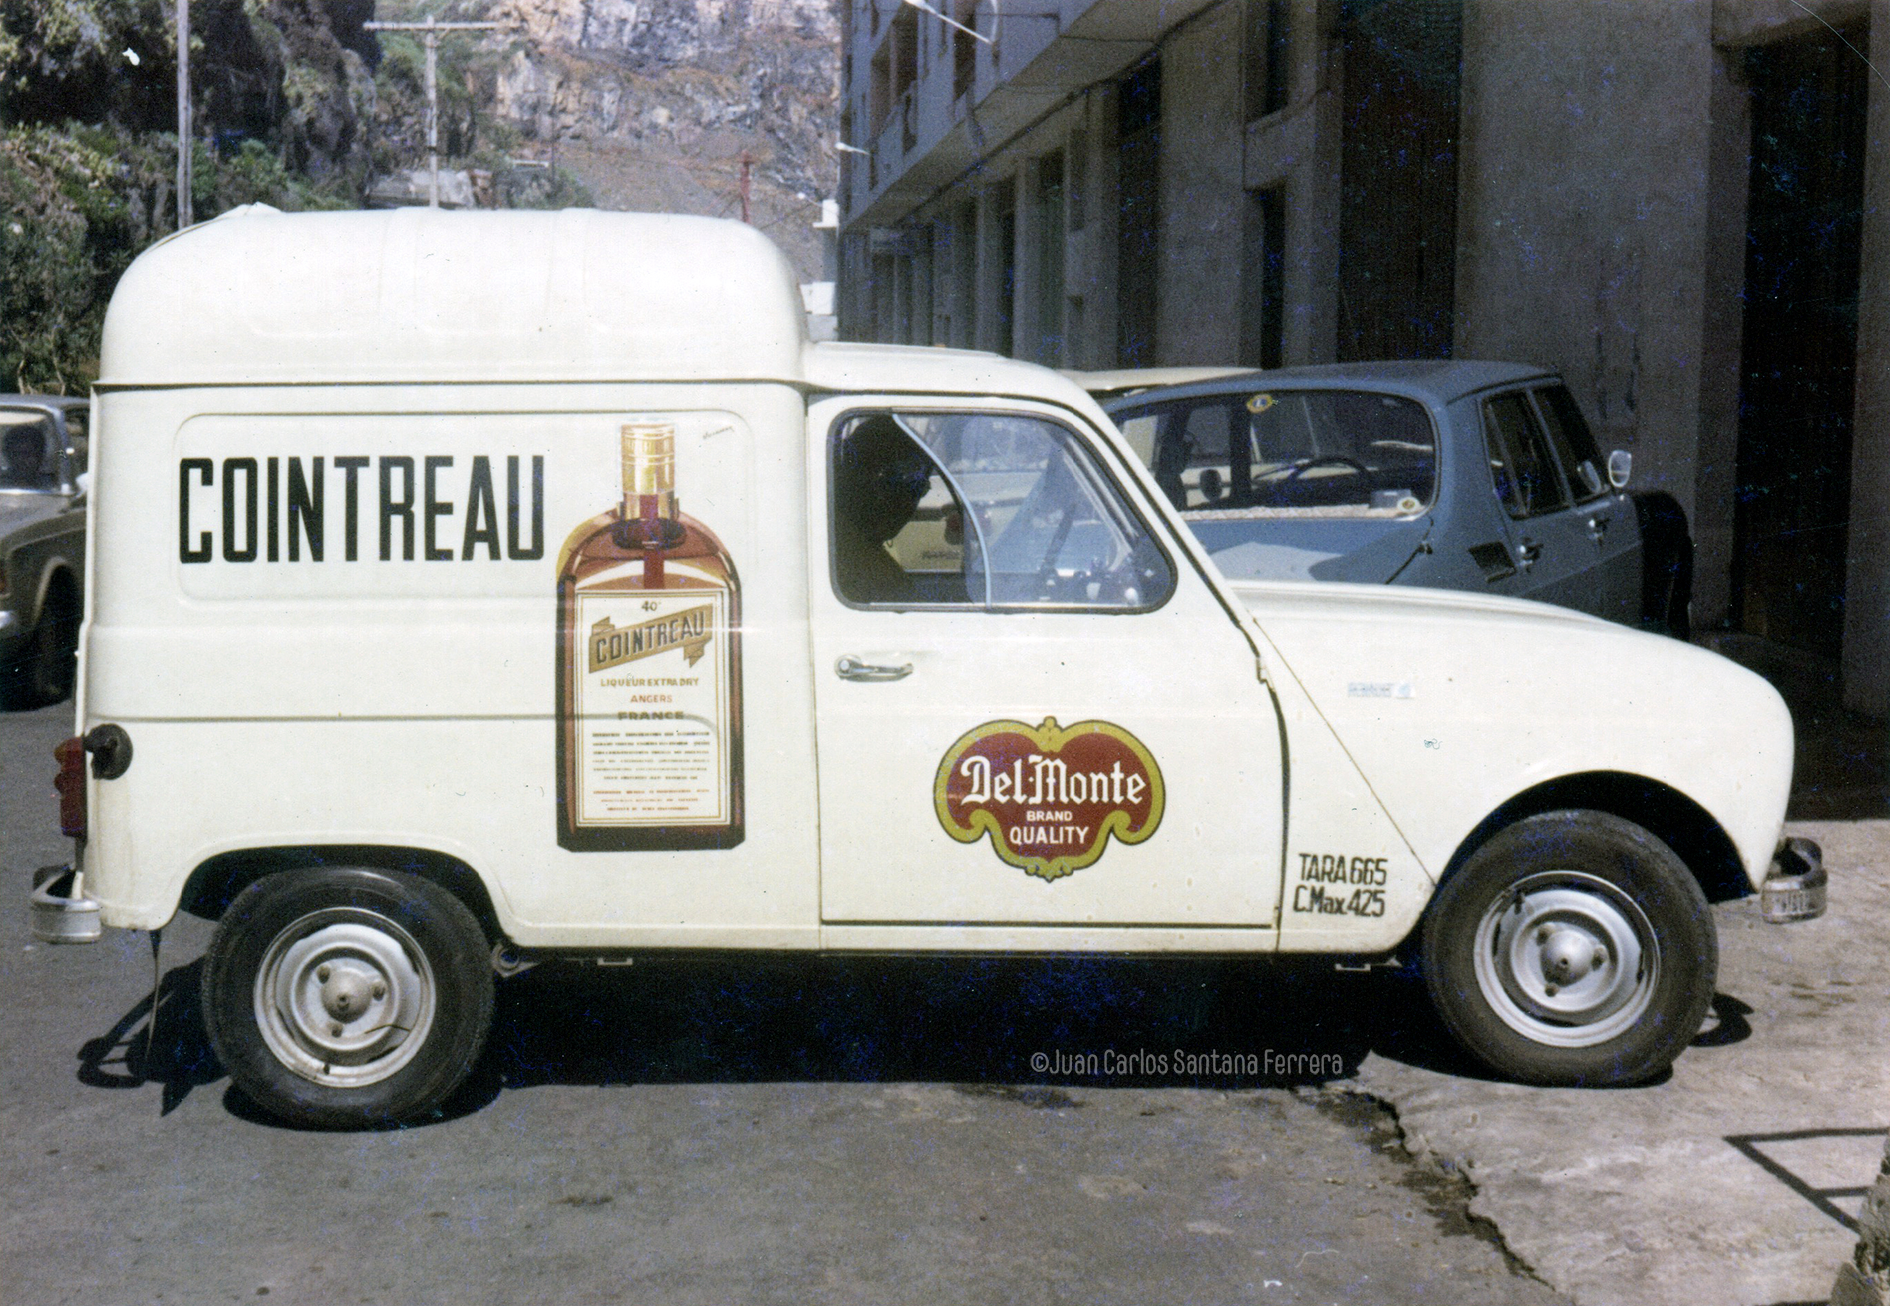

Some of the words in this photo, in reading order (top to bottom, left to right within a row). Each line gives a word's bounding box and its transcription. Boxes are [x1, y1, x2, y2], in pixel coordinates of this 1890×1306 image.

[180, 455, 544, 564] COINTREAU
[596, 611, 705, 664] COINTREAU
[600, 678, 646, 688] LIQUEUR
[647, 678, 678, 687] EXTRA
[680, 677, 699, 687] DRY
[630, 694, 673, 703] ANGERS
[618, 711, 684, 720] FRANCE
[1028, 754, 1146, 805] Monte
[1026, 811, 1073, 822] BRAND
[1010, 826, 1089, 845] QUALITY
[1299, 853, 1347, 883] TARA
[1350, 856, 1388, 886] 665
